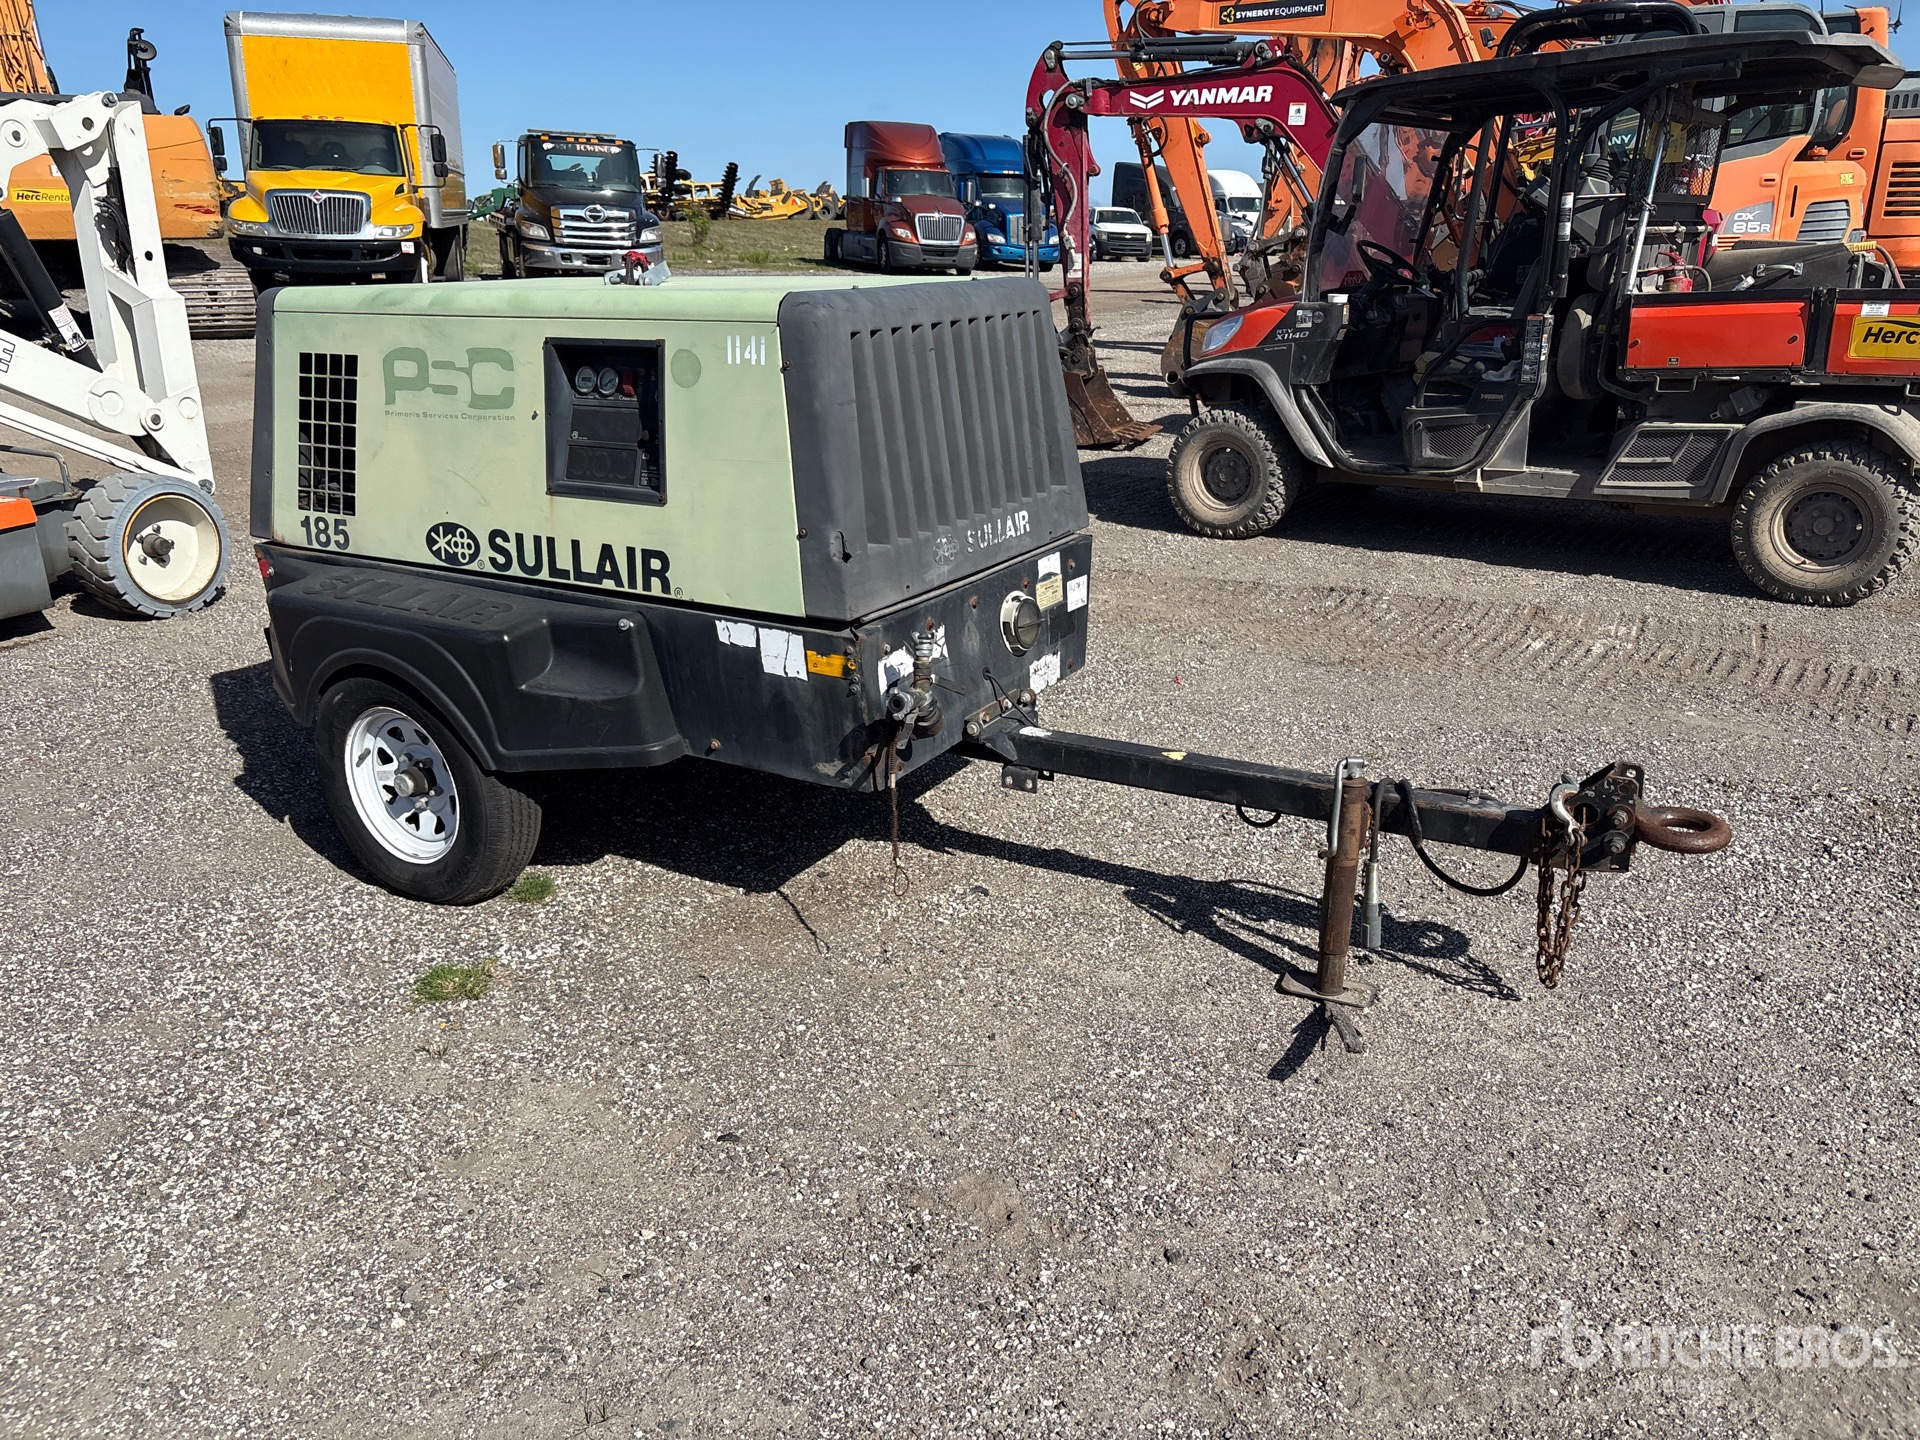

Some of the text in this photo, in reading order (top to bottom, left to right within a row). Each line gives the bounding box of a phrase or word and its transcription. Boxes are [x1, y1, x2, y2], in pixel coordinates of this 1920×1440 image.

[1170, 86, 1273, 106] YANMAR
[1733, 222, 1771, 233] 85R
[727, 335, 766, 366] 1141
[1275, 331, 1309, 340] X1140
[384, 410, 516, 422] Primoris Services Corporation
[300, 515, 350, 551] 185
[966, 509, 1031, 554] SULLAIR
[488, 528, 672, 596] SULLAIR
[301, 575, 514, 625] SULLAIR
